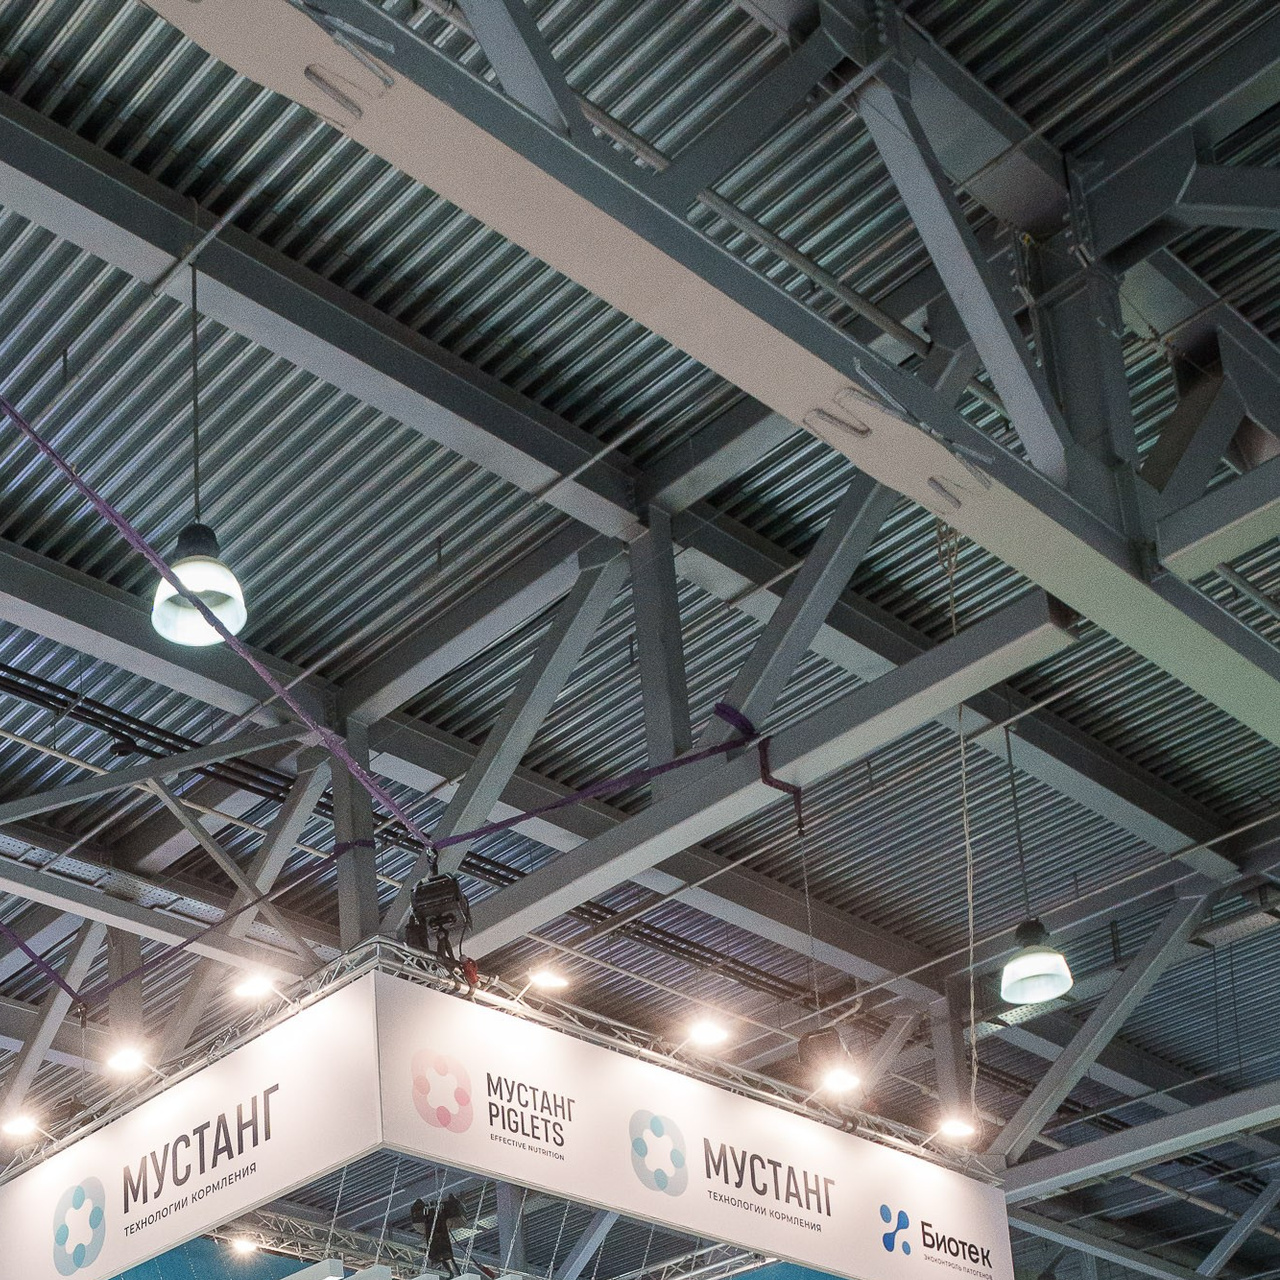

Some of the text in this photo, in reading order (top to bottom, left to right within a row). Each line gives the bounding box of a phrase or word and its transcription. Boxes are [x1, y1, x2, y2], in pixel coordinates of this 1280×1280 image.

[486, 1072, 575, 1122] МУСТАНГ
[123, 1083, 279, 1214] МУСТАНГ
[488, 1101, 565, 1147] PIGLETS
[490, 1133, 565, 1161] EFFECTIVE NUTRITION
[124, 1162, 257, 1237] ТЕХНОЛОГИИ КОРМЛЕНИЯ
[703, 1137, 835, 1217] МУСТАНГ
[707, 1190, 822, 1232] ТЕХНОЛОГИИ КОРМЛЕНИЯ
[921, 1220, 992, 1269] Биотек
[963, 1267, 993, 1280] ПАТОГЕНОВ
